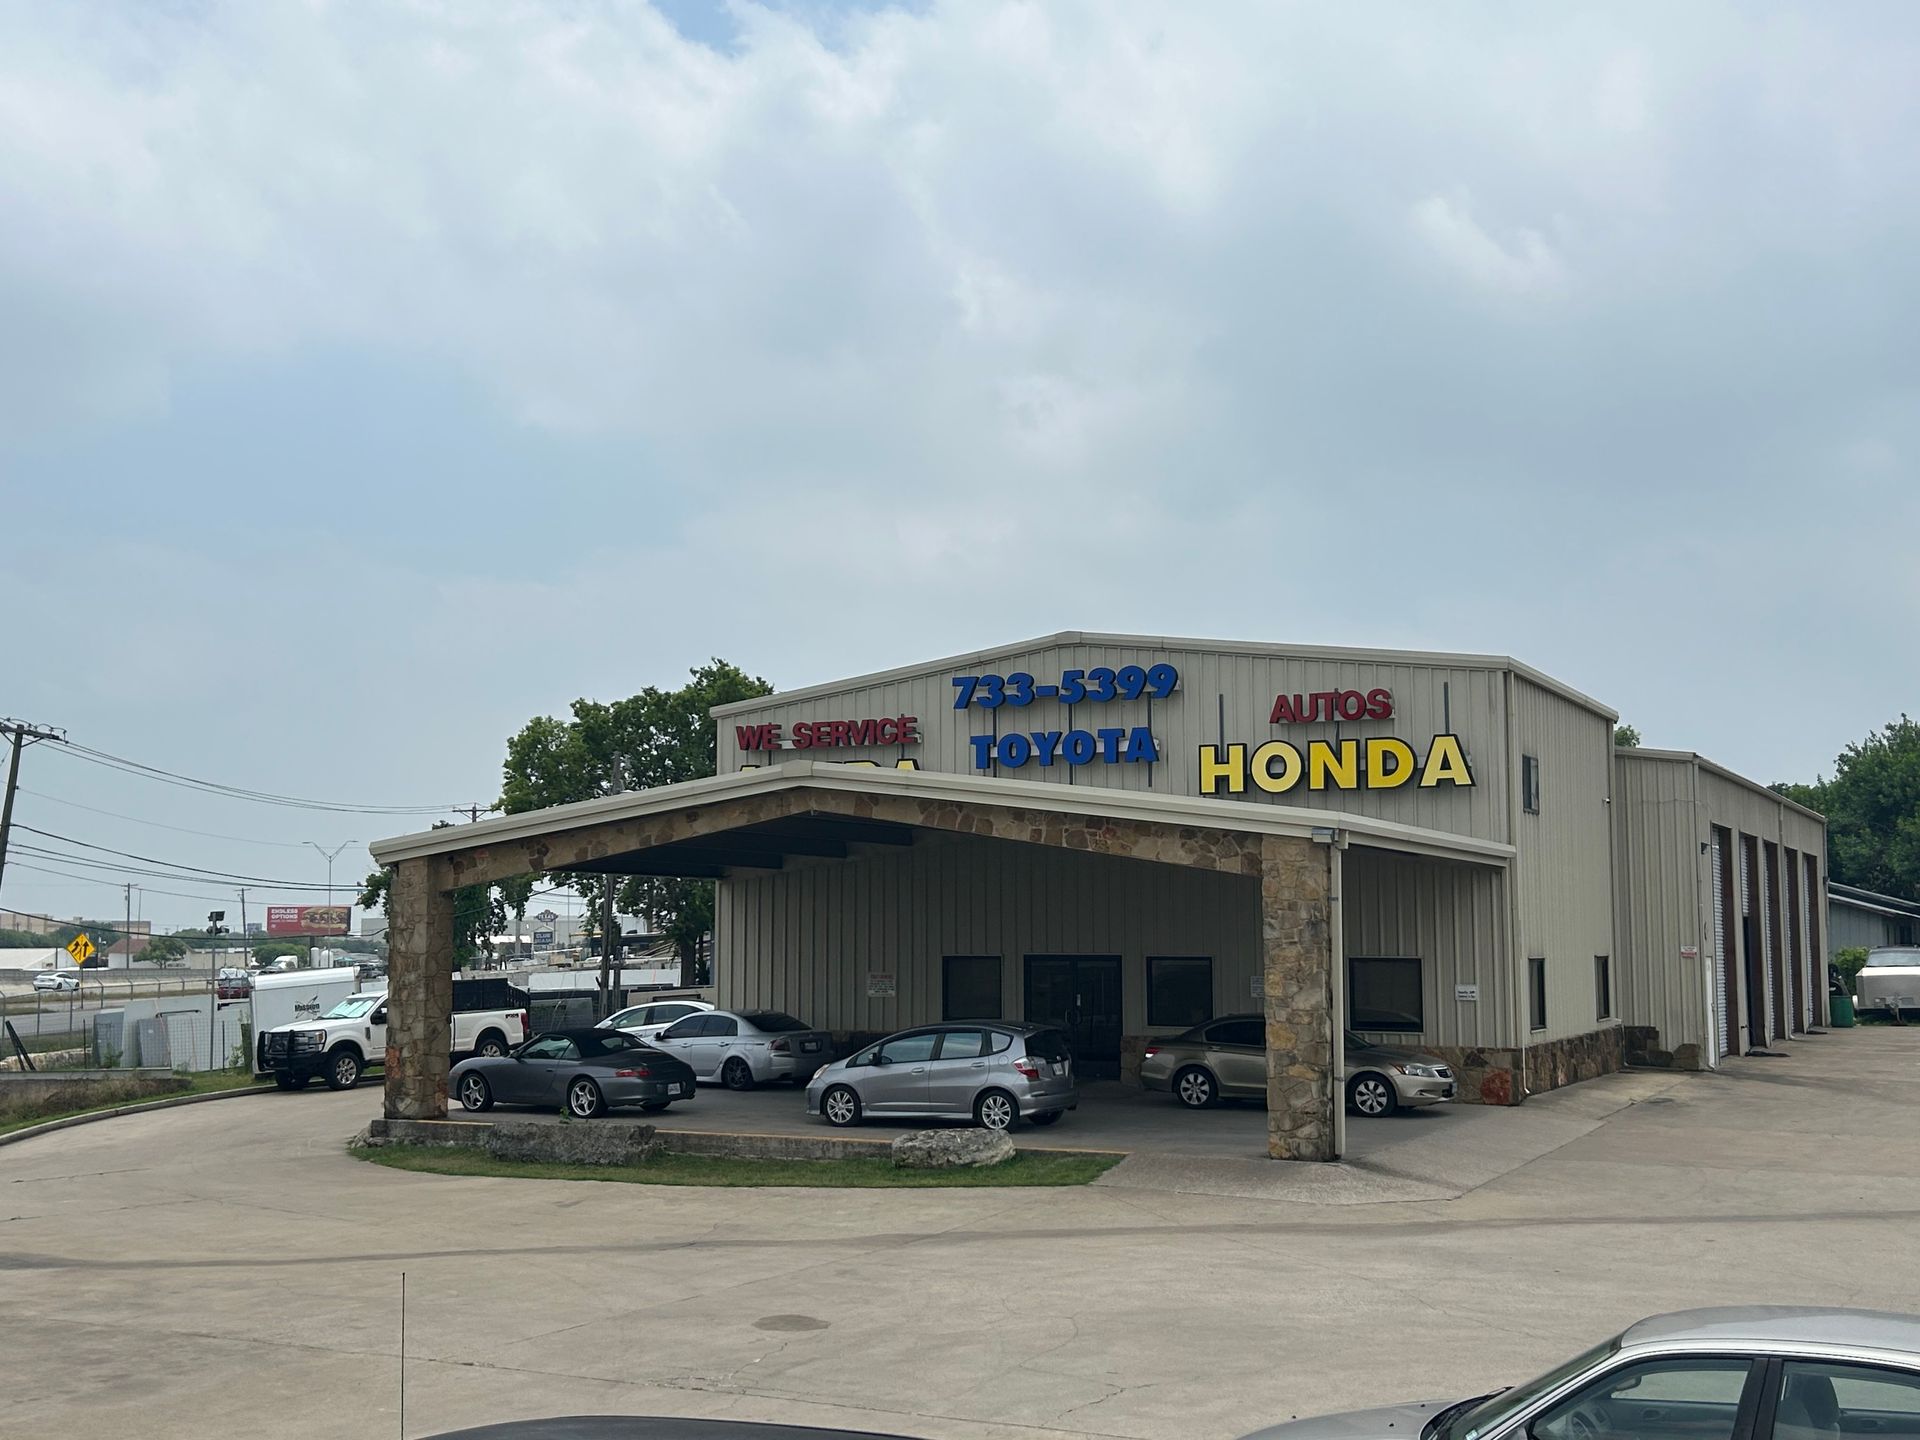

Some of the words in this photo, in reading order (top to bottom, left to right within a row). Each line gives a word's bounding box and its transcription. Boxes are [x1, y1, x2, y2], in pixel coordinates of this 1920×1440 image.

[952, 663, 1178, 709] 733-5399
[1269, 688, 1394, 723] AUTOS
[736, 723, 782, 750] WE
[792, 716, 918, 749] SERVICE
[970, 727, 1159, 769] TOYOTA
[1199, 733, 1476, 795] HONDA
